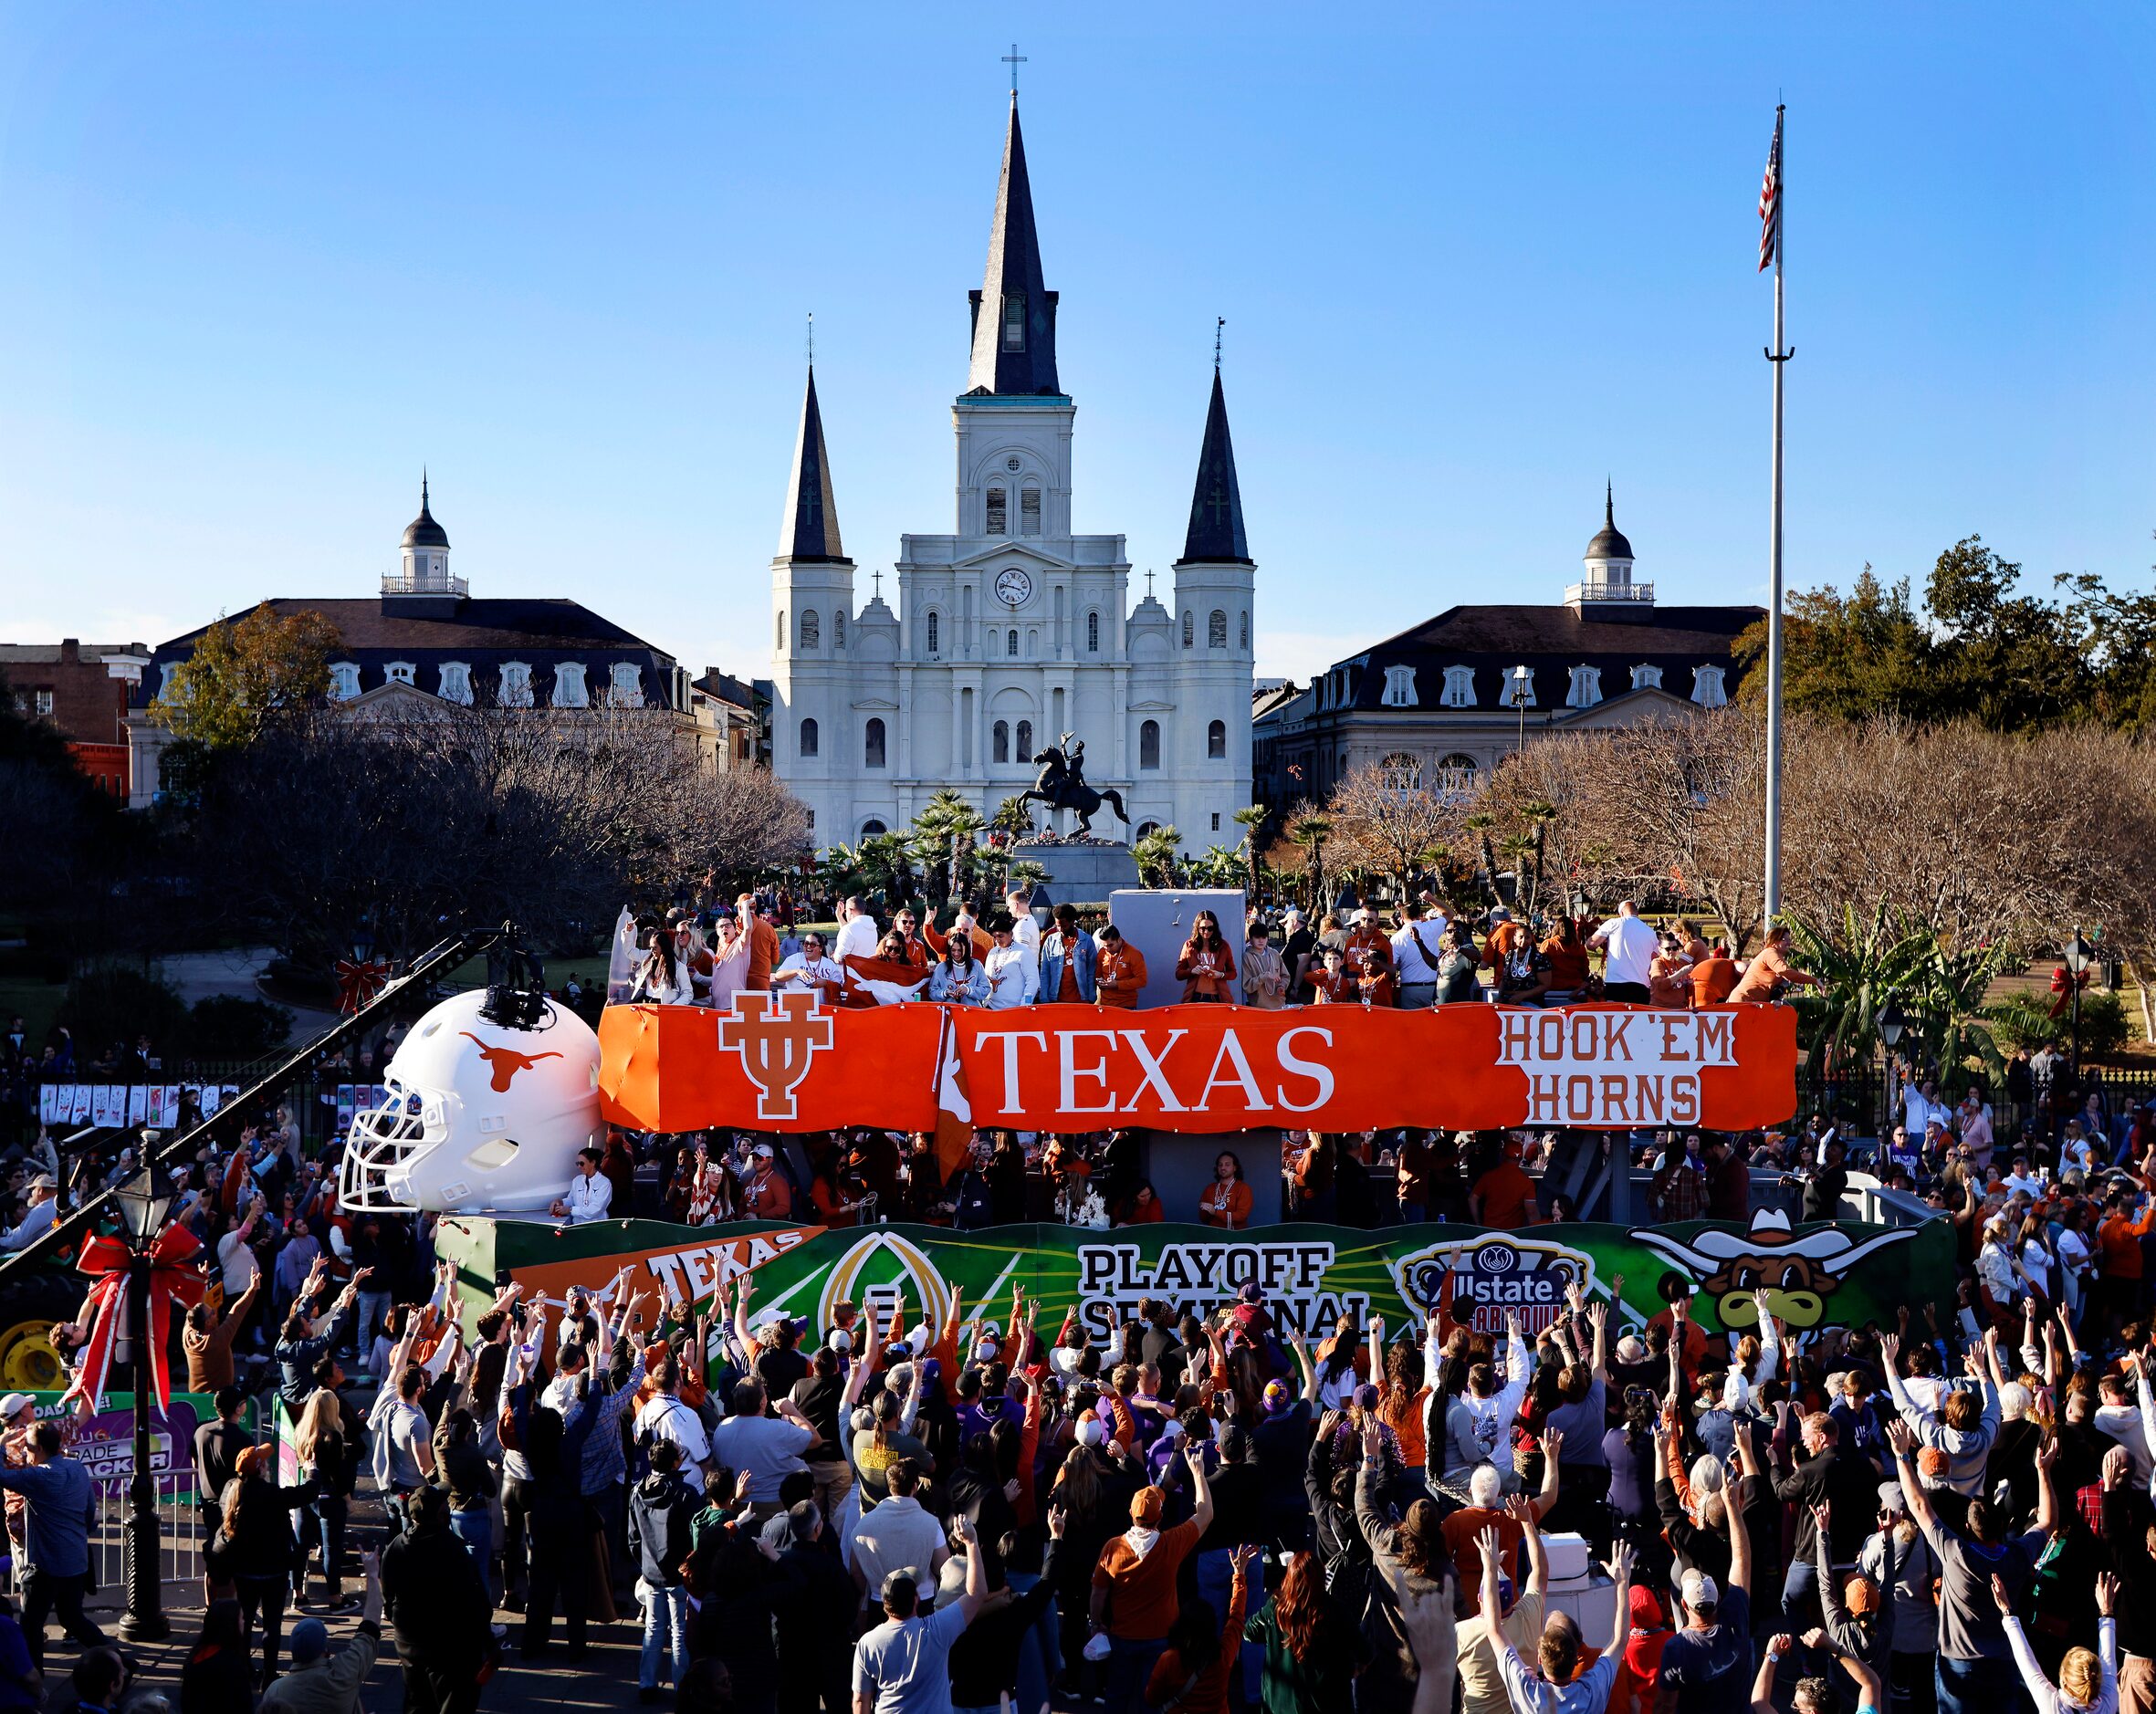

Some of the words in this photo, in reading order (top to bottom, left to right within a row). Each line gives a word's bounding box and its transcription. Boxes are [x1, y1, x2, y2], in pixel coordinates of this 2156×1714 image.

[1504, 1015, 1634, 1061] HOOK
[1648, 1015, 1733, 1062] 'EM
[975, 1027, 1335, 1114] TEXAS
[1533, 1074, 1699, 1122] HORNS
[644, 1231, 803, 1307] TEXAS
[1083, 1248, 1329, 1290] PLAYOFF
[1085, 1298, 1370, 1343] SEINAL
